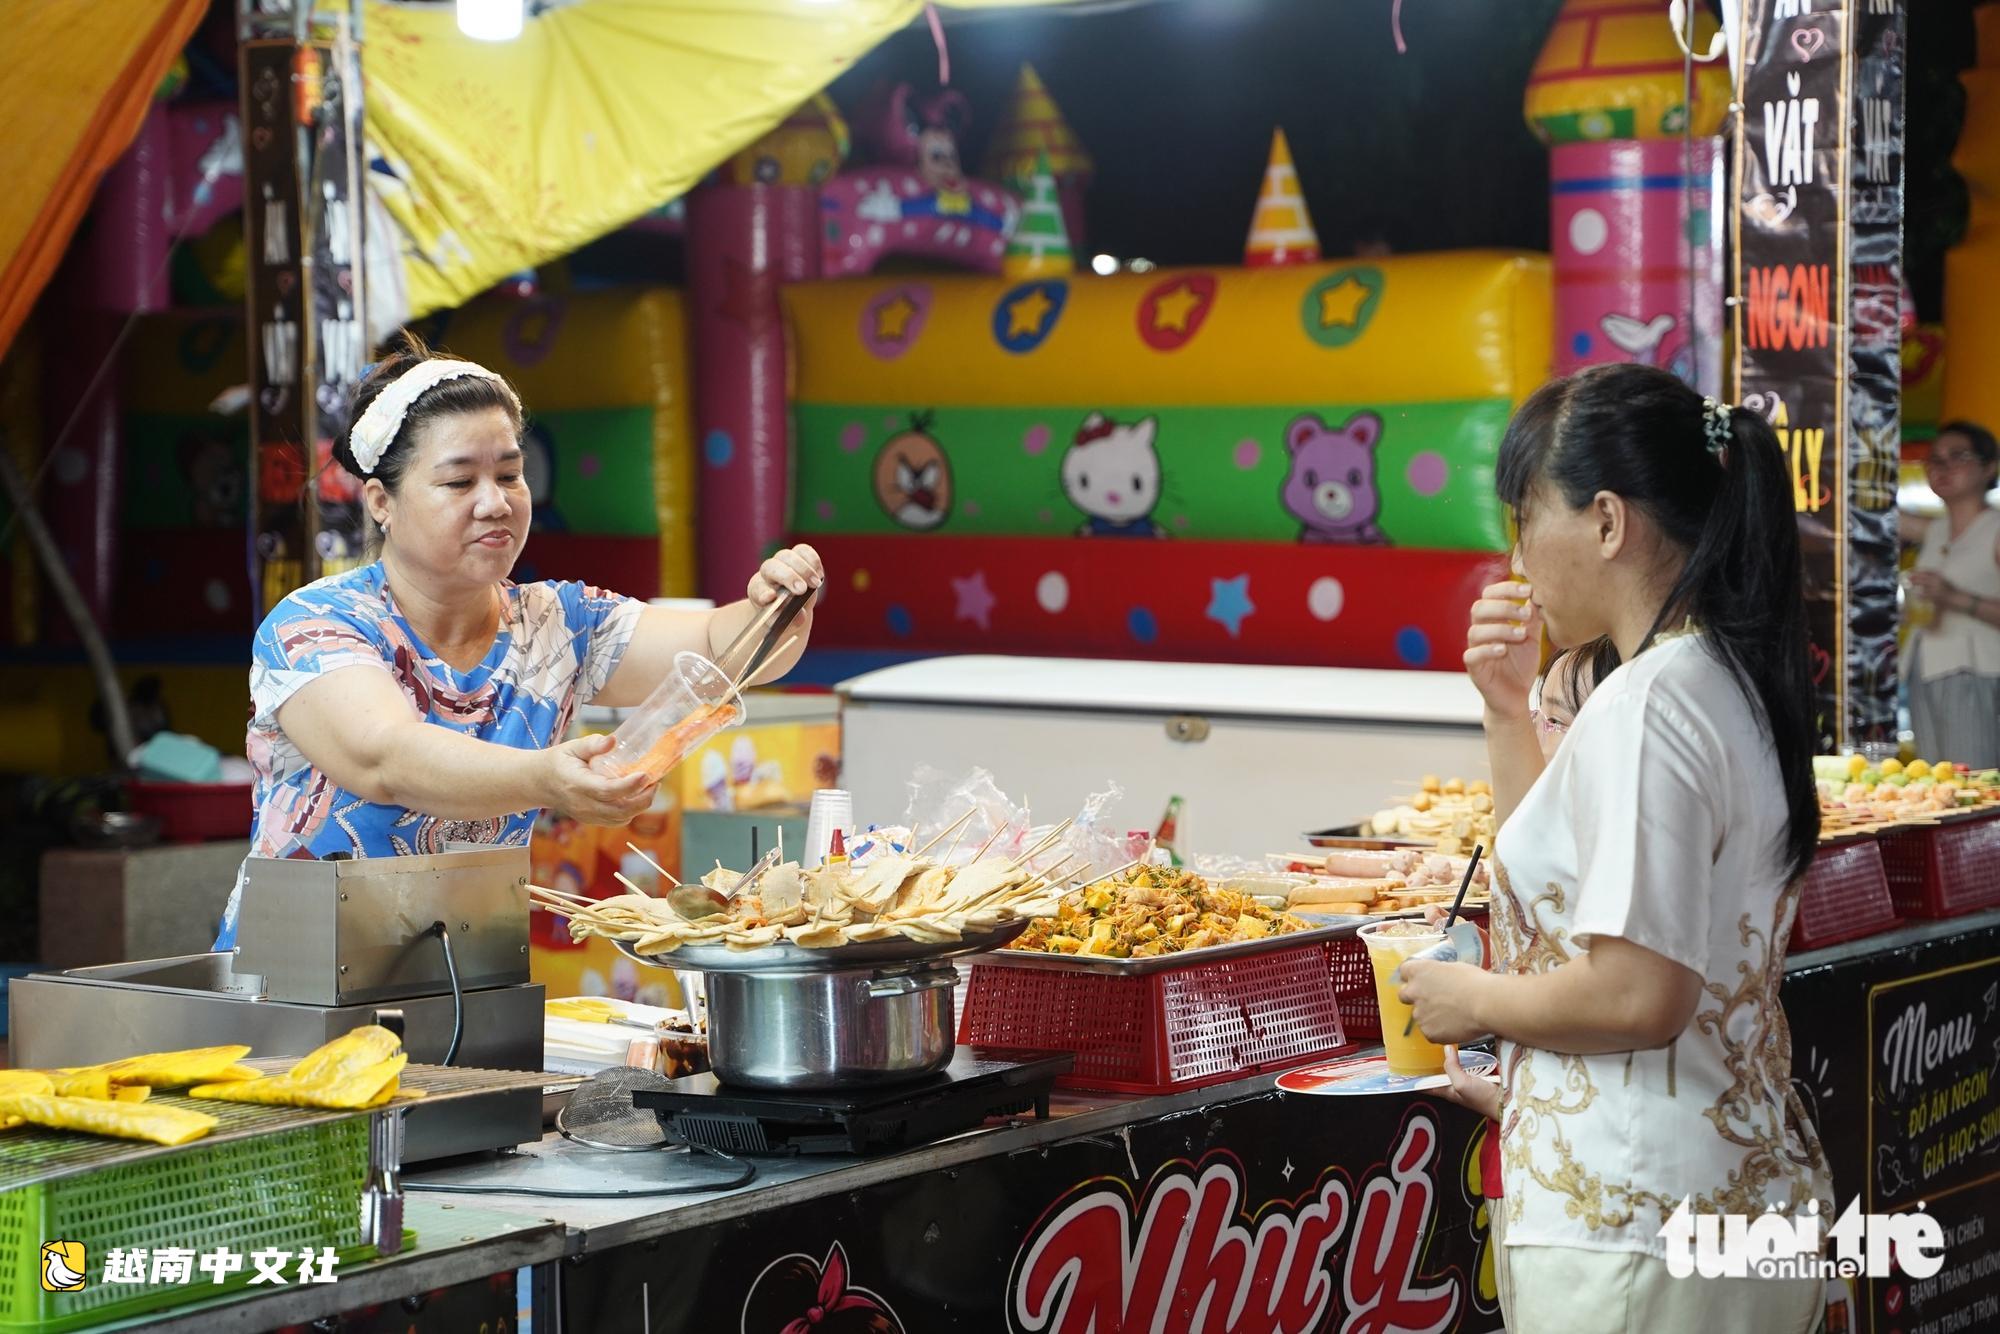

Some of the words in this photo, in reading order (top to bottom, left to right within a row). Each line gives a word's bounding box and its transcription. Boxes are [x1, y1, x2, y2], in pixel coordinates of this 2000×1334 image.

[1747, 263, 1830, 352] NGON
[1883, 1001, 1976, 1094] Menu
[1950, 1068, 1988, 1114] NGON
[1923, 1132, 1946, 1179] GIÁ
[1947, 1122, 1977, 1165] HỌC
[1017, 1163, 1350, 1334] Như
